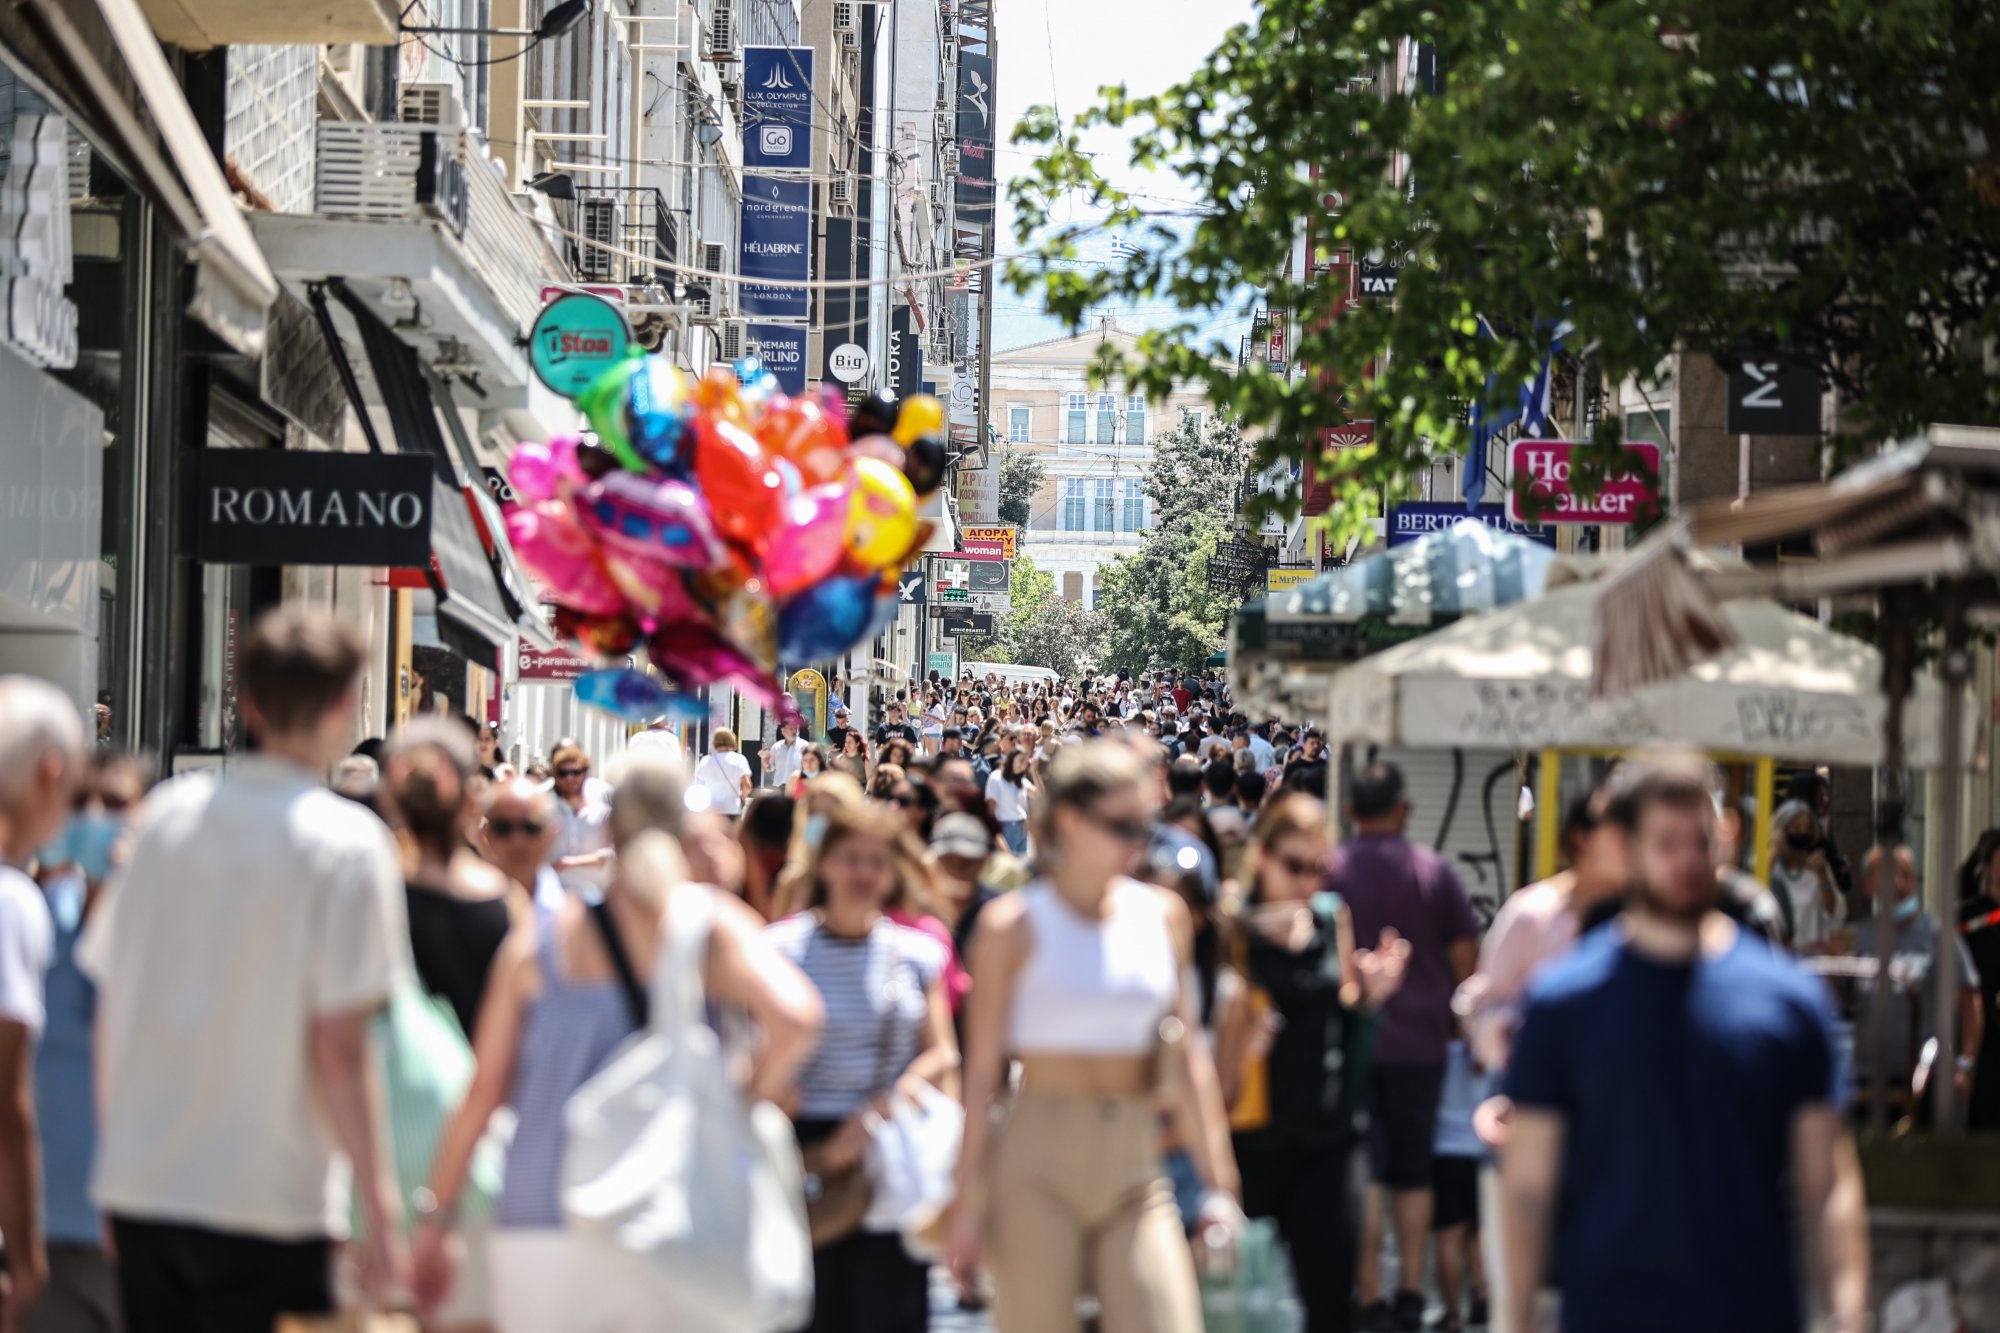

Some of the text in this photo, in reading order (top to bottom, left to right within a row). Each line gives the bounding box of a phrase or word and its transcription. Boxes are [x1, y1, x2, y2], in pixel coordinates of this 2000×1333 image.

[747, 92, 764, 100] LUX
[766, 132, 786, 145] Go
[746, 204, 804, 213] nordgreen
[744, 241, 804, 254] HÉLIABRINE
[1361, 278, 1398, 292] TAT
[755, 340, 799, 350] NEMARIE
[835, 355, 862, 369] Big
[890, 330, 900, 400] HORA
[211, 486, 421, 528] ROMANO
[965, 547, 1002, 555] woman
[1279, 575, 1313, 584] MrPhon
